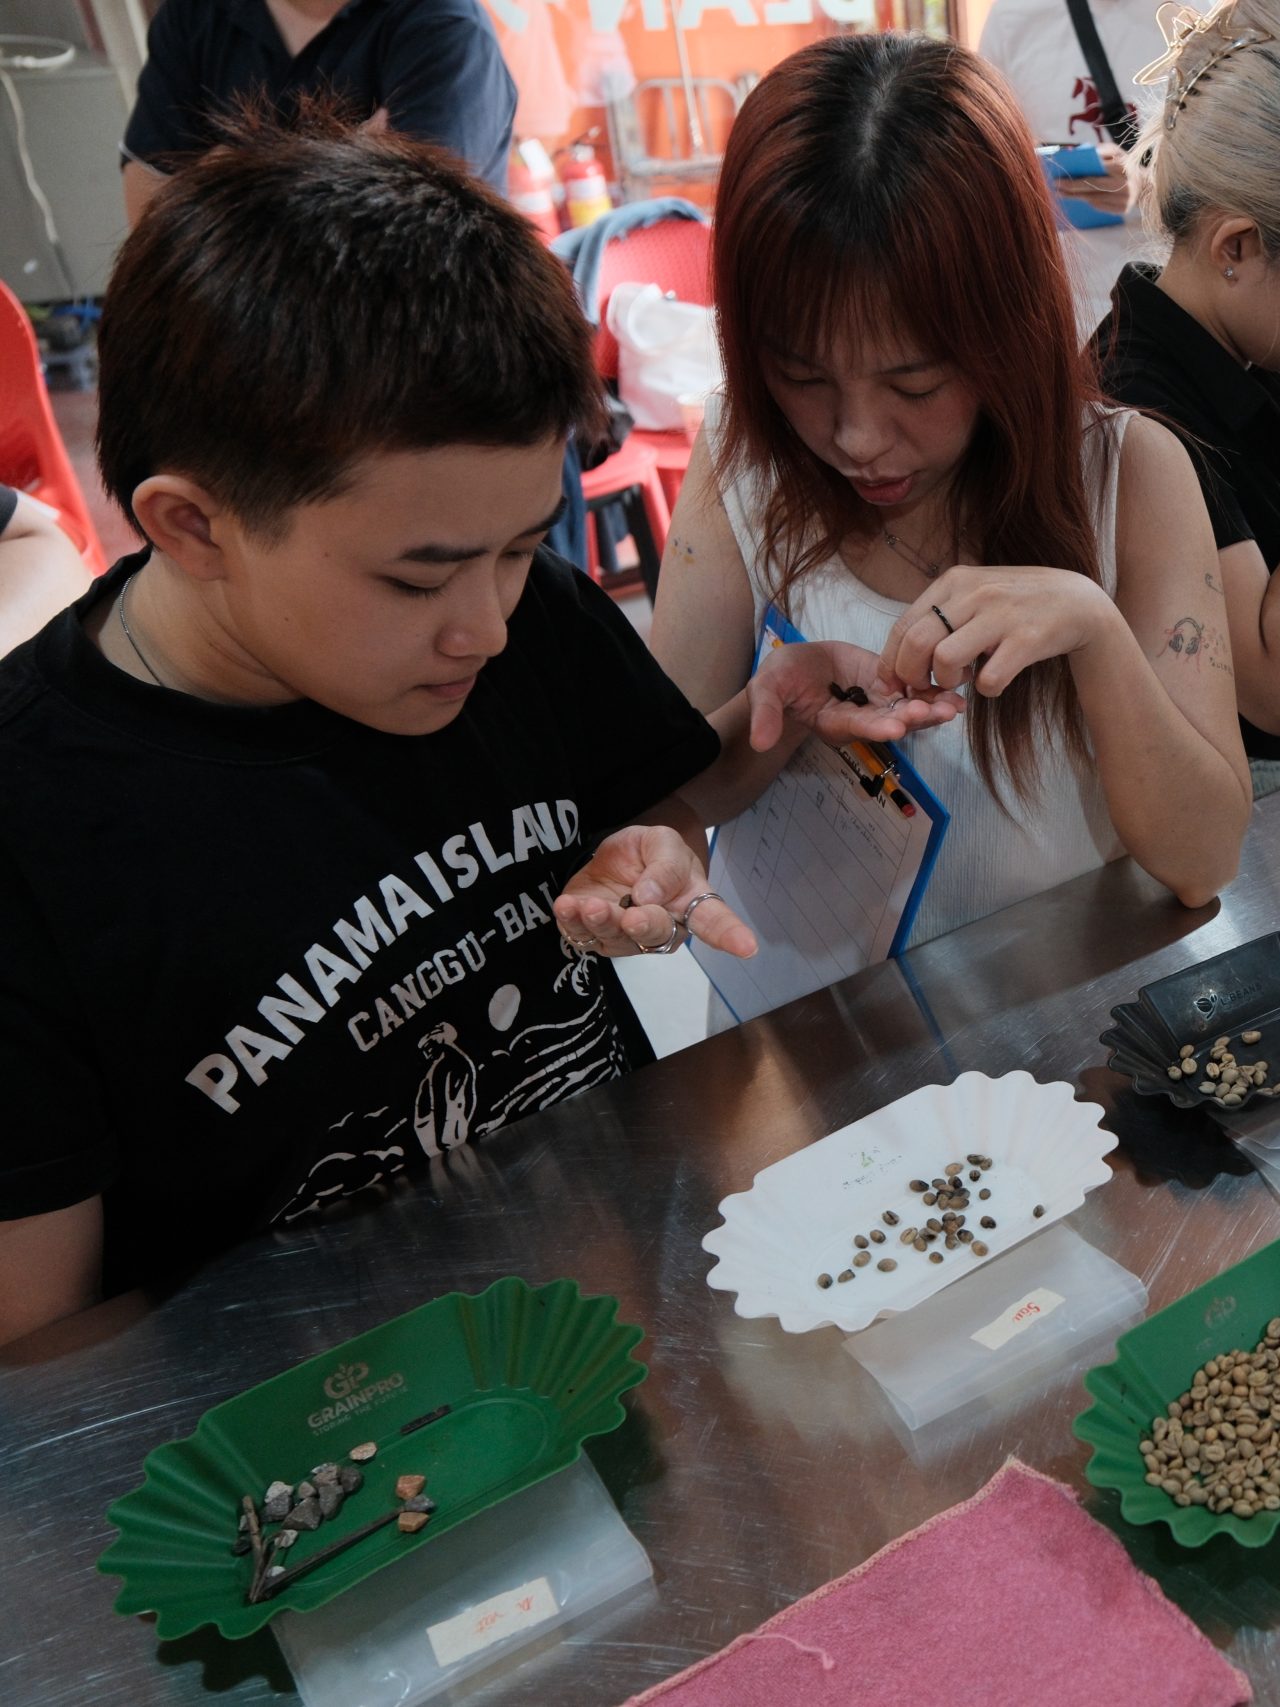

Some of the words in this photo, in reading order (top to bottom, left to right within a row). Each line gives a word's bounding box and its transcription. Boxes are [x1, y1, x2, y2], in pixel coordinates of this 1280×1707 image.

[184, 873, 435, 1115] PANAMA
[413, 799, 582, 904] ISLAND
[307, 1372, 404, 1428] GRAINPRO
